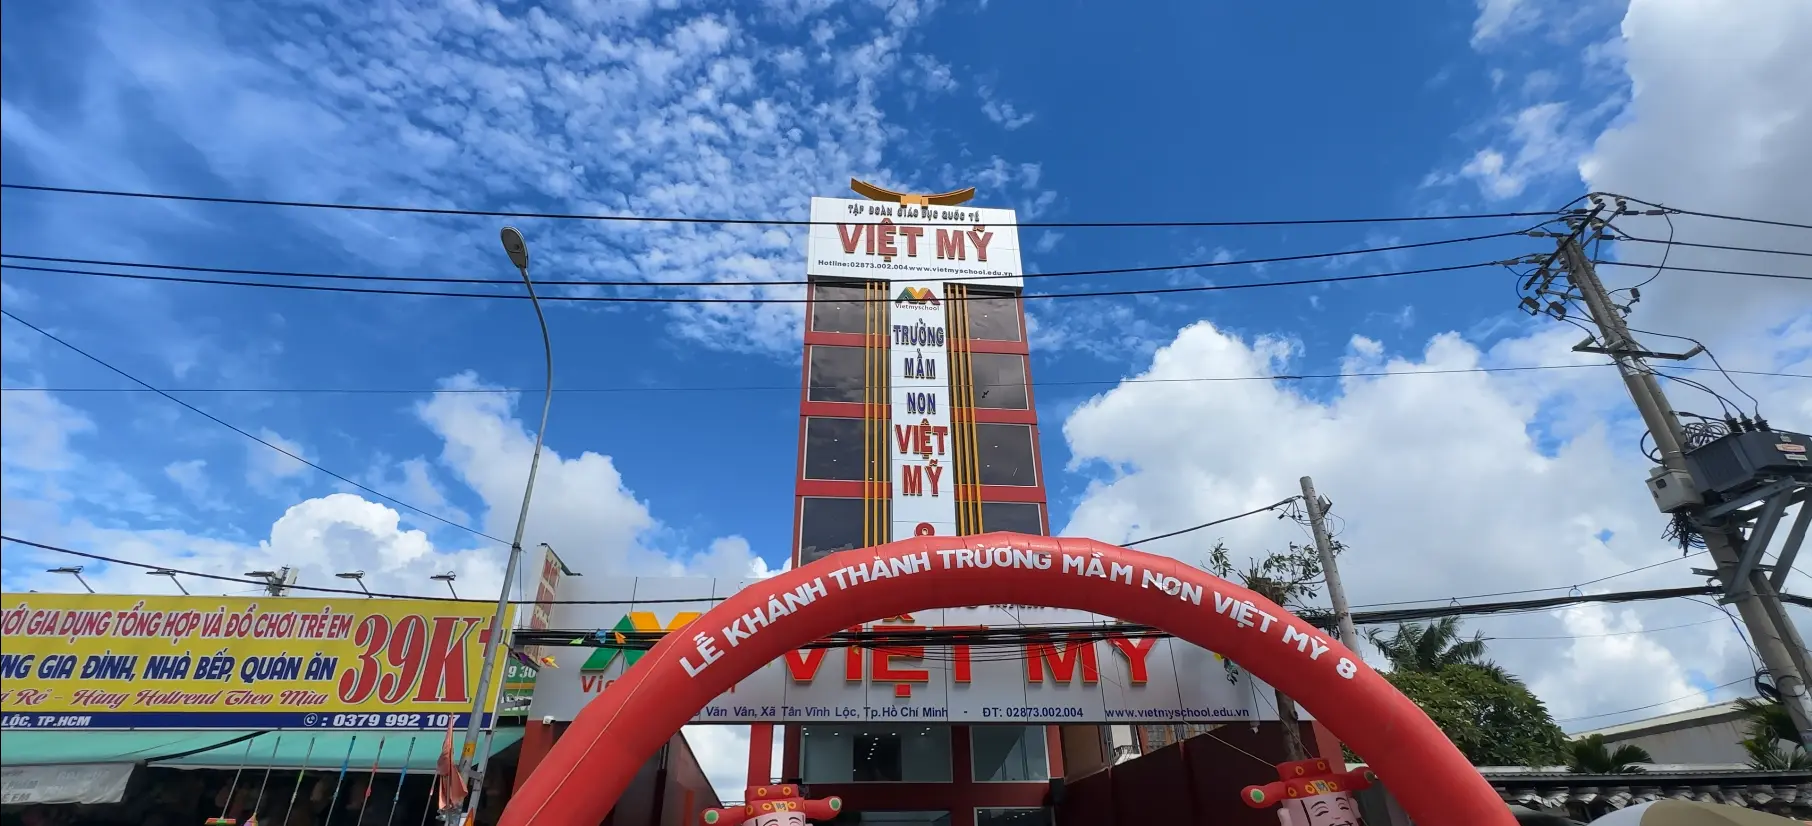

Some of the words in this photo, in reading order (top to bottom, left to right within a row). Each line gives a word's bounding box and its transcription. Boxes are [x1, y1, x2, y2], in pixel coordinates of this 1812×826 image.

[848, 204, 864, 216] TẬP
[868, 205, 893, 217] ĐOÀN
[897, 206, 919, 218] GIÁO
[921, 208, 939, 222] DỤC
[941, 210, 965, 221] QUỐC
[837, 217, 924, 262] VIỆT
[936, 224, 994, 262] MỸ
[895, 303, 940, 311] Vietmyschool
[893, 318, 944, 347] TRƯỜNG
[904, 348, 936, 379] MẦM
[907, 392, 936, 415] NON
[894, 418, 948, 459] VIỆT
[903, 459, 943, 497] MỸ
[27, 610, 60, 636] GIA
[58, 610, 112, 644] DỤNG
[112, 600, 162, 637] TỔNG
[160, 610, 201, 645] HỢP
[201, 606, 224, 637] VÀ
[253, 611, 297, 638] CHƠI
[297, 606, 331, 639] TRẺ
[326, 614, 354, 639] EM
[679, 632, 725, 678] LỄ
[722, 577, 828, 648] KHÁNH
[828, 551, 931, 590] THÀNH
[1062, 551, 1134, 585] MẦM
[1141, 568, 1203, 606] NON
[1213, 591, 1278, 633] VIỆT
[1336, 657, 1357, 679] 8
[1, 654, 35, 679] NG
[38, 654, 77, 679] GIA
[80, 650, 139, 682] ĐÌNH,
[142, 650, 191, 680] NHÀ
[193, 647, 235, 682] BẾP,
[240, 652, 303, 683] QUÁN
[304, 652, 339, 680] ĂN
[13, 688, 52, 705] Rẻ
[70, 689, 130, 709] Hàng
[224, 689, 274, 706] Theo
[279, 690, 329, 706] Mùa
[706, 706, 727, 717] Văn
[733, 706, 758, 718] Vân,
[760, 706, 776, 717] Xã
[781, 706, 802, 717] Tân
[805, 706, 830, 717] Vĩnh
[835, 707, 860, 719] Lộc,
[900, 707, 919, 717] Chí
[923, 706, 948, 717] Minh
[983, 707, 1002, 718] ĐT:
[1006, 707, 1083, 718] 02873.002.004
[1106, 706, 1250, 720] www.vietmyschool.edu.vn
[2, 714, 31, 728] LỘC,
[37, 715, 92, 727] TP.HCM
[333, 714, 380, 727] 0379
[385, 714, 419, 727] 992
[426, 714, 460, 727] 107
